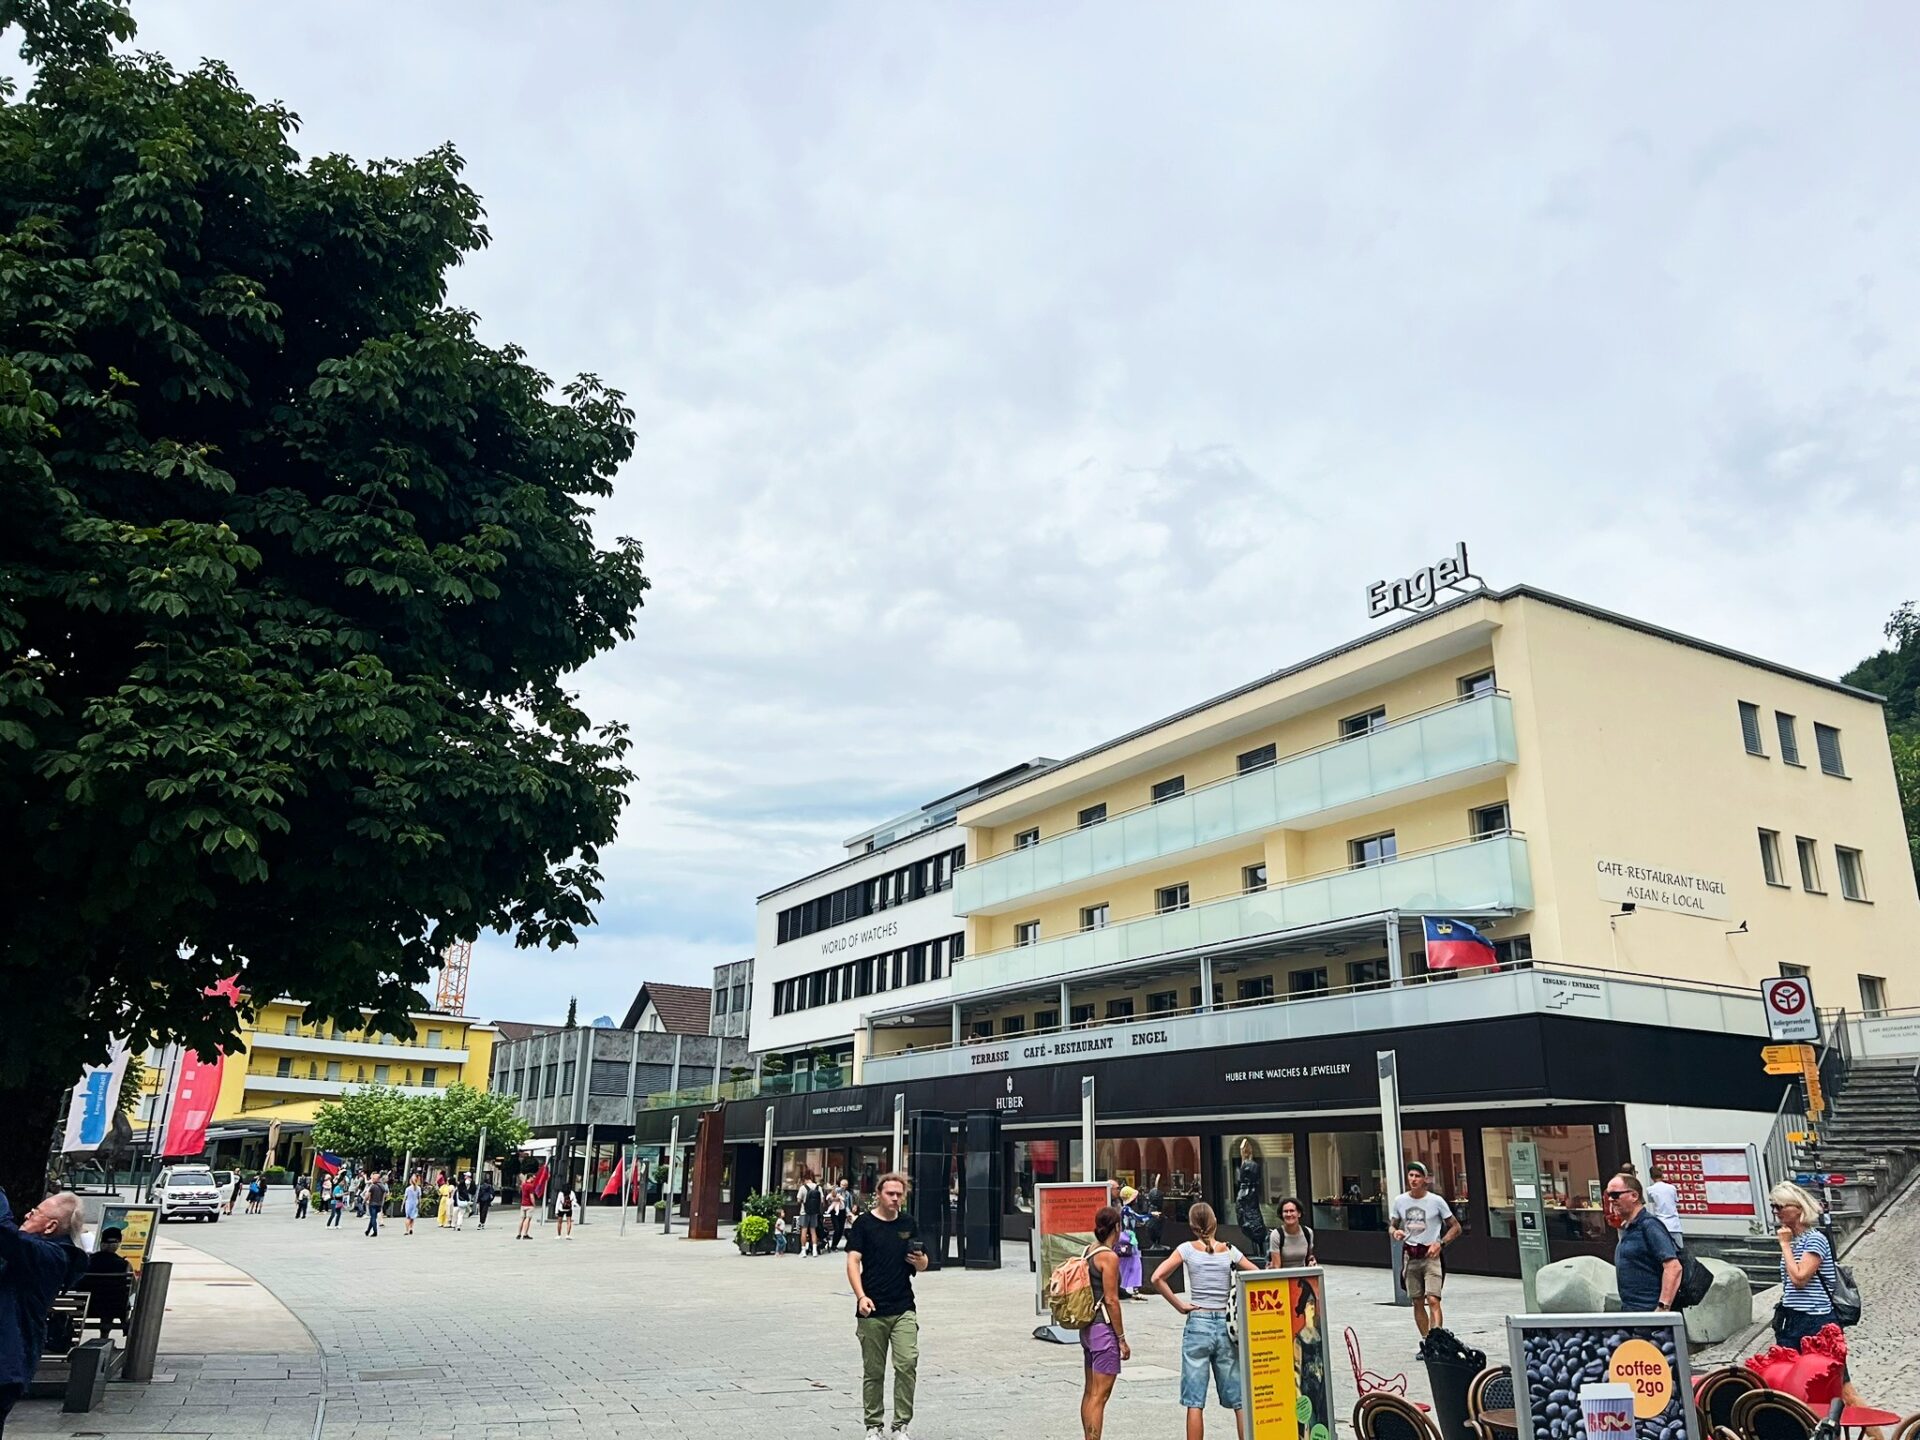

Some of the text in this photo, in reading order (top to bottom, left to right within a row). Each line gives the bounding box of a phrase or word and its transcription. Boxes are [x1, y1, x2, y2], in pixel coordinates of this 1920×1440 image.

[1366, 541, 1469, 618] Engel
[1696, 879, 1726, 895] ENGEL
[1627, 886, 1704, 910] ASIAN & LOCAL
[821, 921, 898, 955] WORLD OF WATCHES
[1543, 977, 1567, 986] EINGANG
[1572, 981, 1600, 990] ENTRANCE
[971, 1050, 1010, 1065] TERRASSE
[1132, 1031, 1168, 1046] ENGEL
[1225, 1064, 1351, 1081] HUBER FINE WATCHES & JEWELLERY
[996, 1096, 1024, 1109] HUBER
[1616, 1361, 1661, 1377] coffee
[1636, 1379, 1664, 1397] 2go
